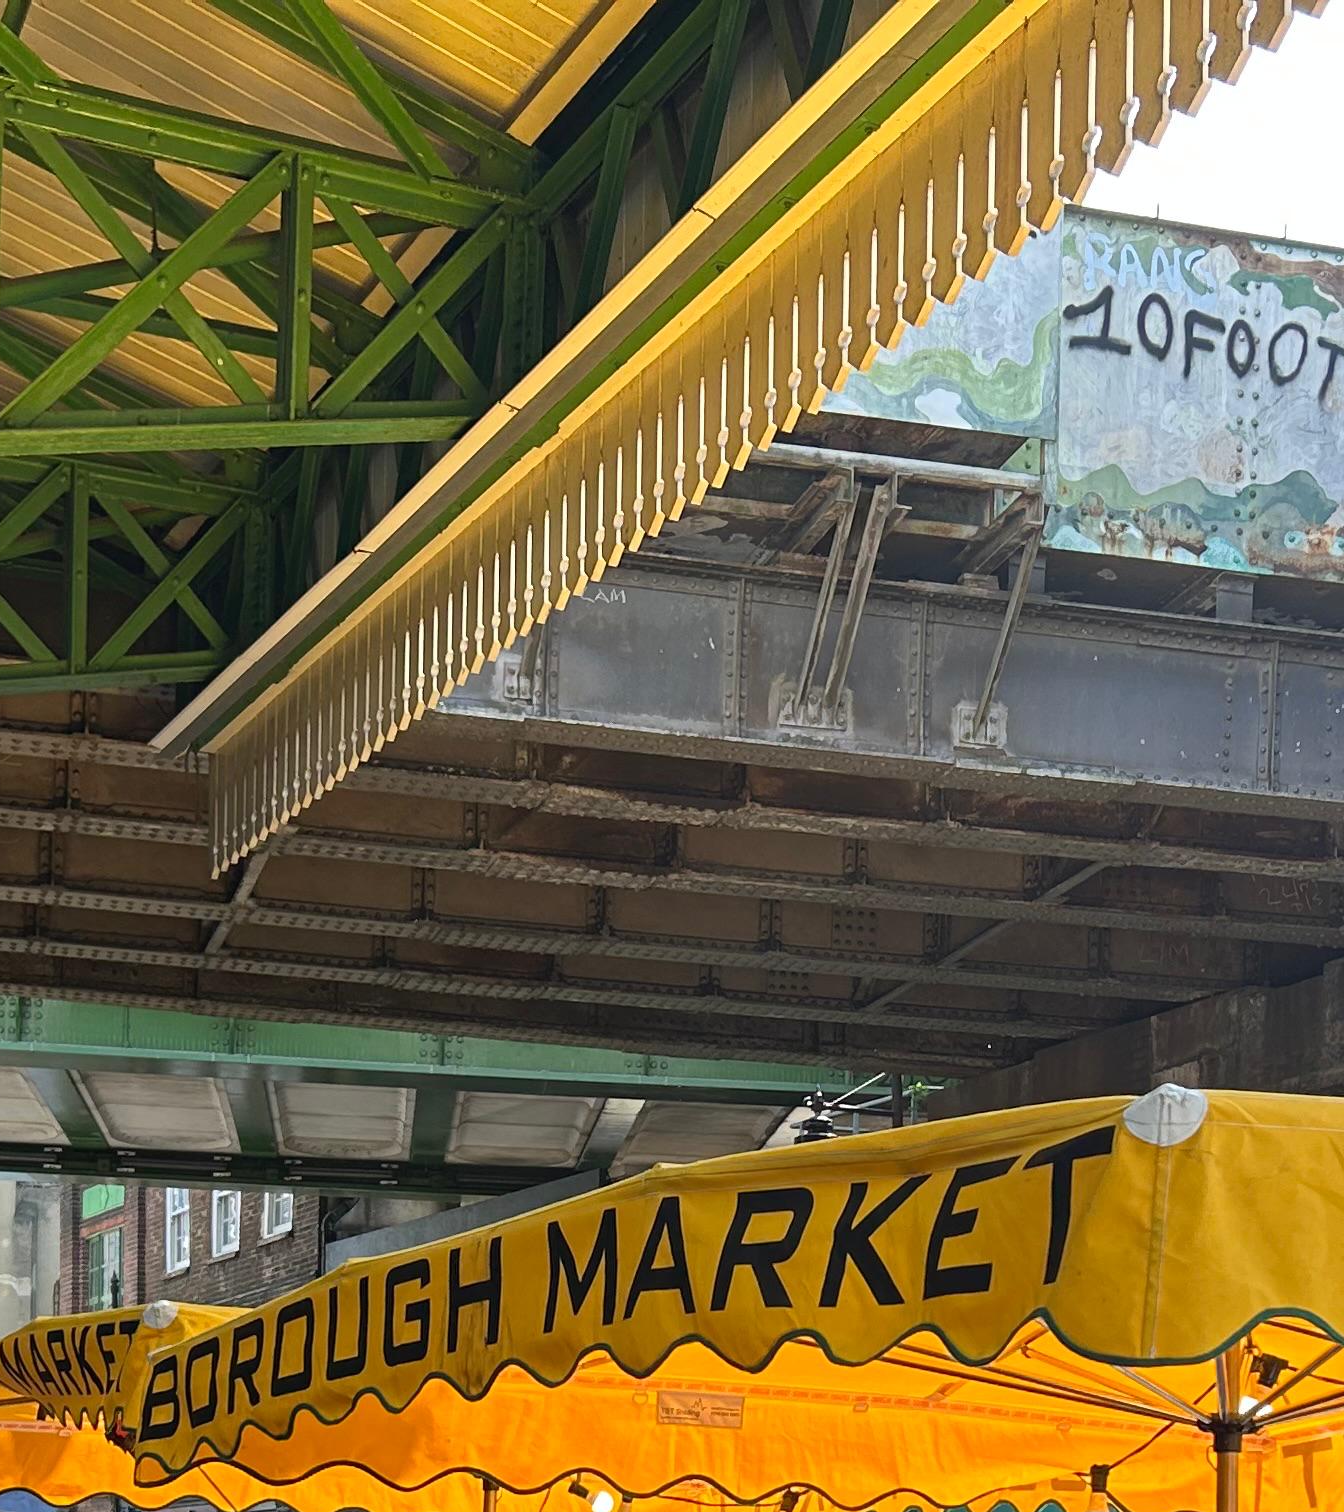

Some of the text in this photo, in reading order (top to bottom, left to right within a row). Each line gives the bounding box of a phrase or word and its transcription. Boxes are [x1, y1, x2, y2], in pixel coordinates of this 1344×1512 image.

[0, 1319, 141, 1398] MARKET
[138, 1125, 1116, 1443] BOROUGH MARKET
